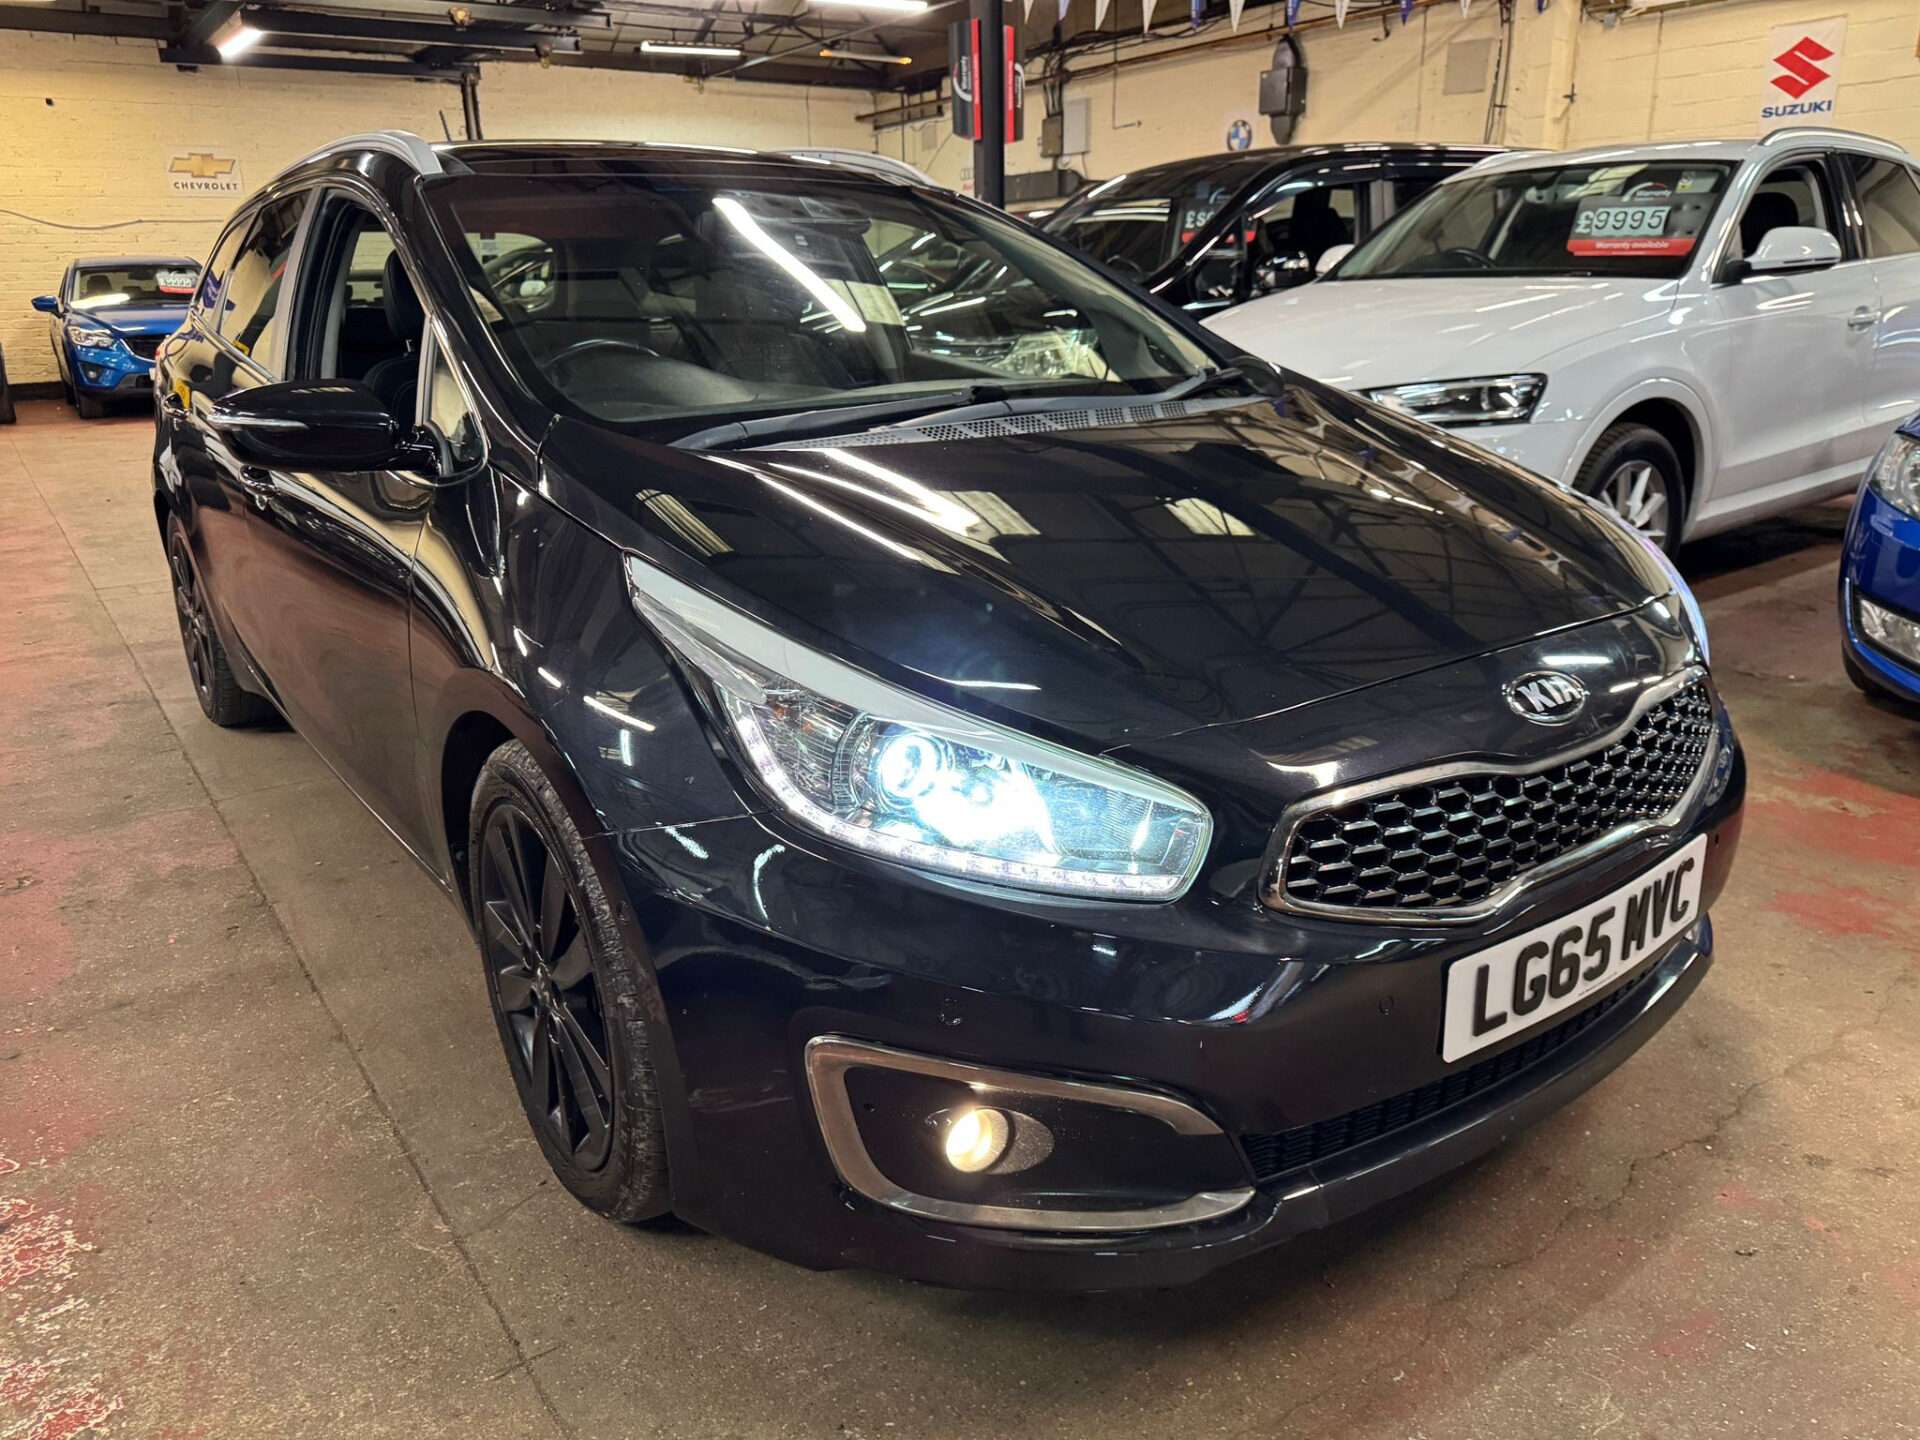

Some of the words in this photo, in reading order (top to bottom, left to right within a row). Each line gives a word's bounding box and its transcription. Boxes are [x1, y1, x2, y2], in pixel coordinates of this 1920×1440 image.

[1760, 99, 1832, 118] SUZUKI
[173, 181, 238, 191] CHEVROLET
[1575, 208, 1667, 234] £9995
[1516, 675, 1582, 713] KIA
[1471, 905, 1616, 1038] LG65
[1620, 856, 1696, 962] MVC
